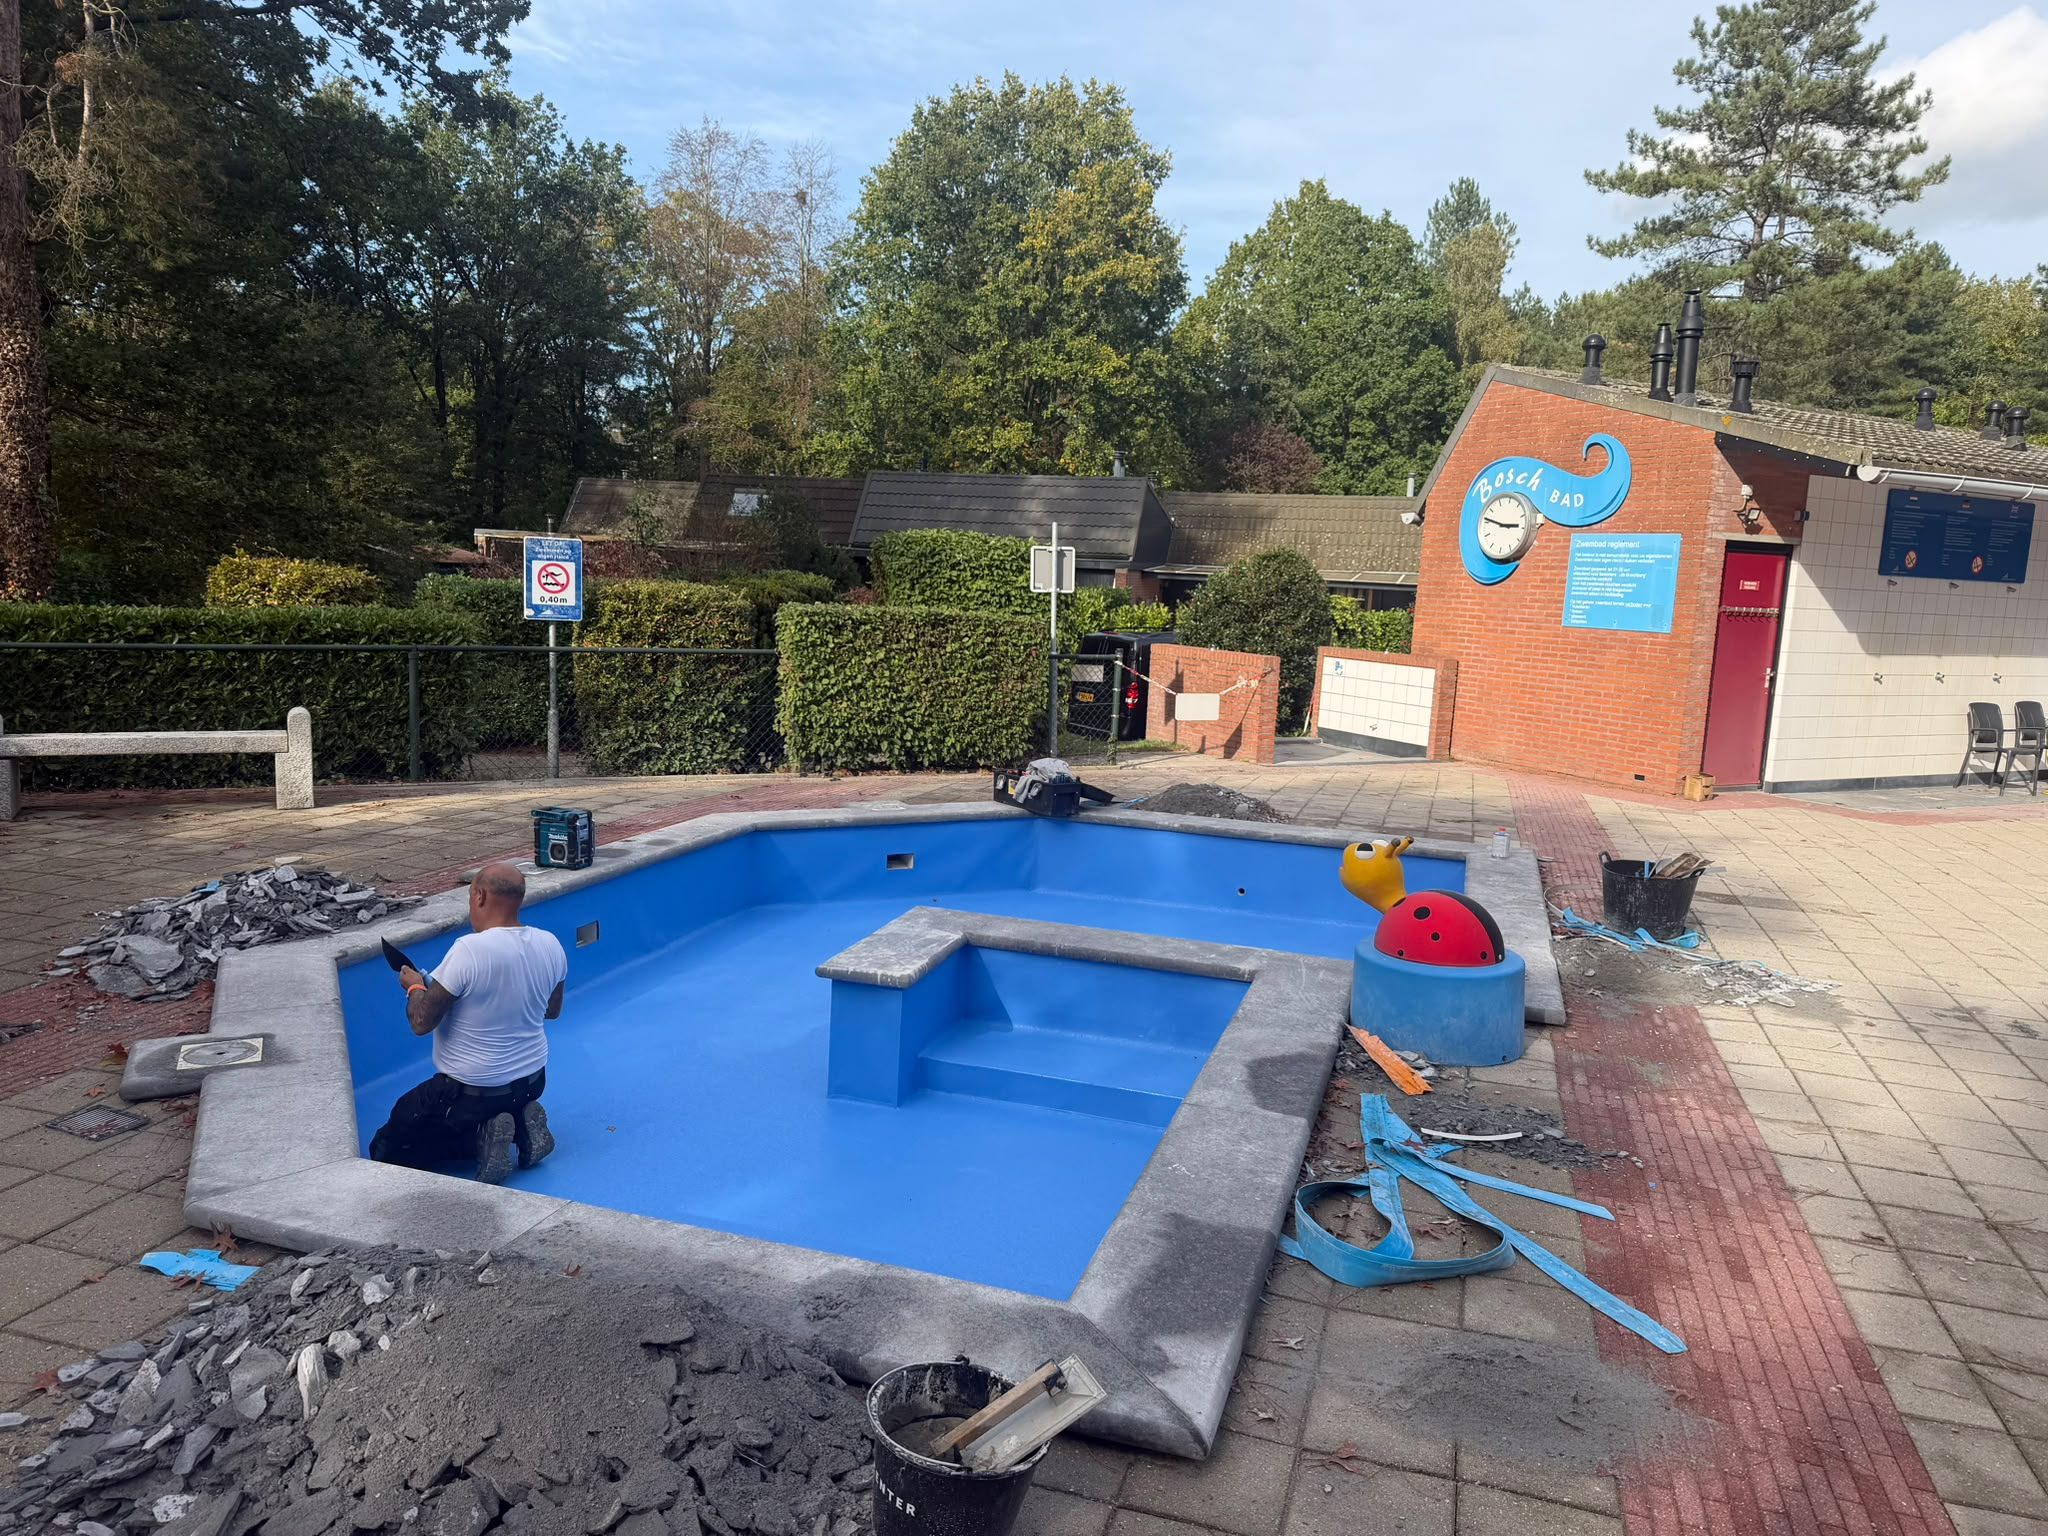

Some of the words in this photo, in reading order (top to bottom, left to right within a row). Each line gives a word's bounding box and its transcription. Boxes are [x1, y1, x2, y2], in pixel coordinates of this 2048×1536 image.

[1472, 467, 1544, 504] Bosch
[1549, 488, 1585, 508] BAD
[1575, 540, 1607, 548] Zwembad
[1607, 541, 1640, 550] reglement
[547, 833, 569, 841] Makita
